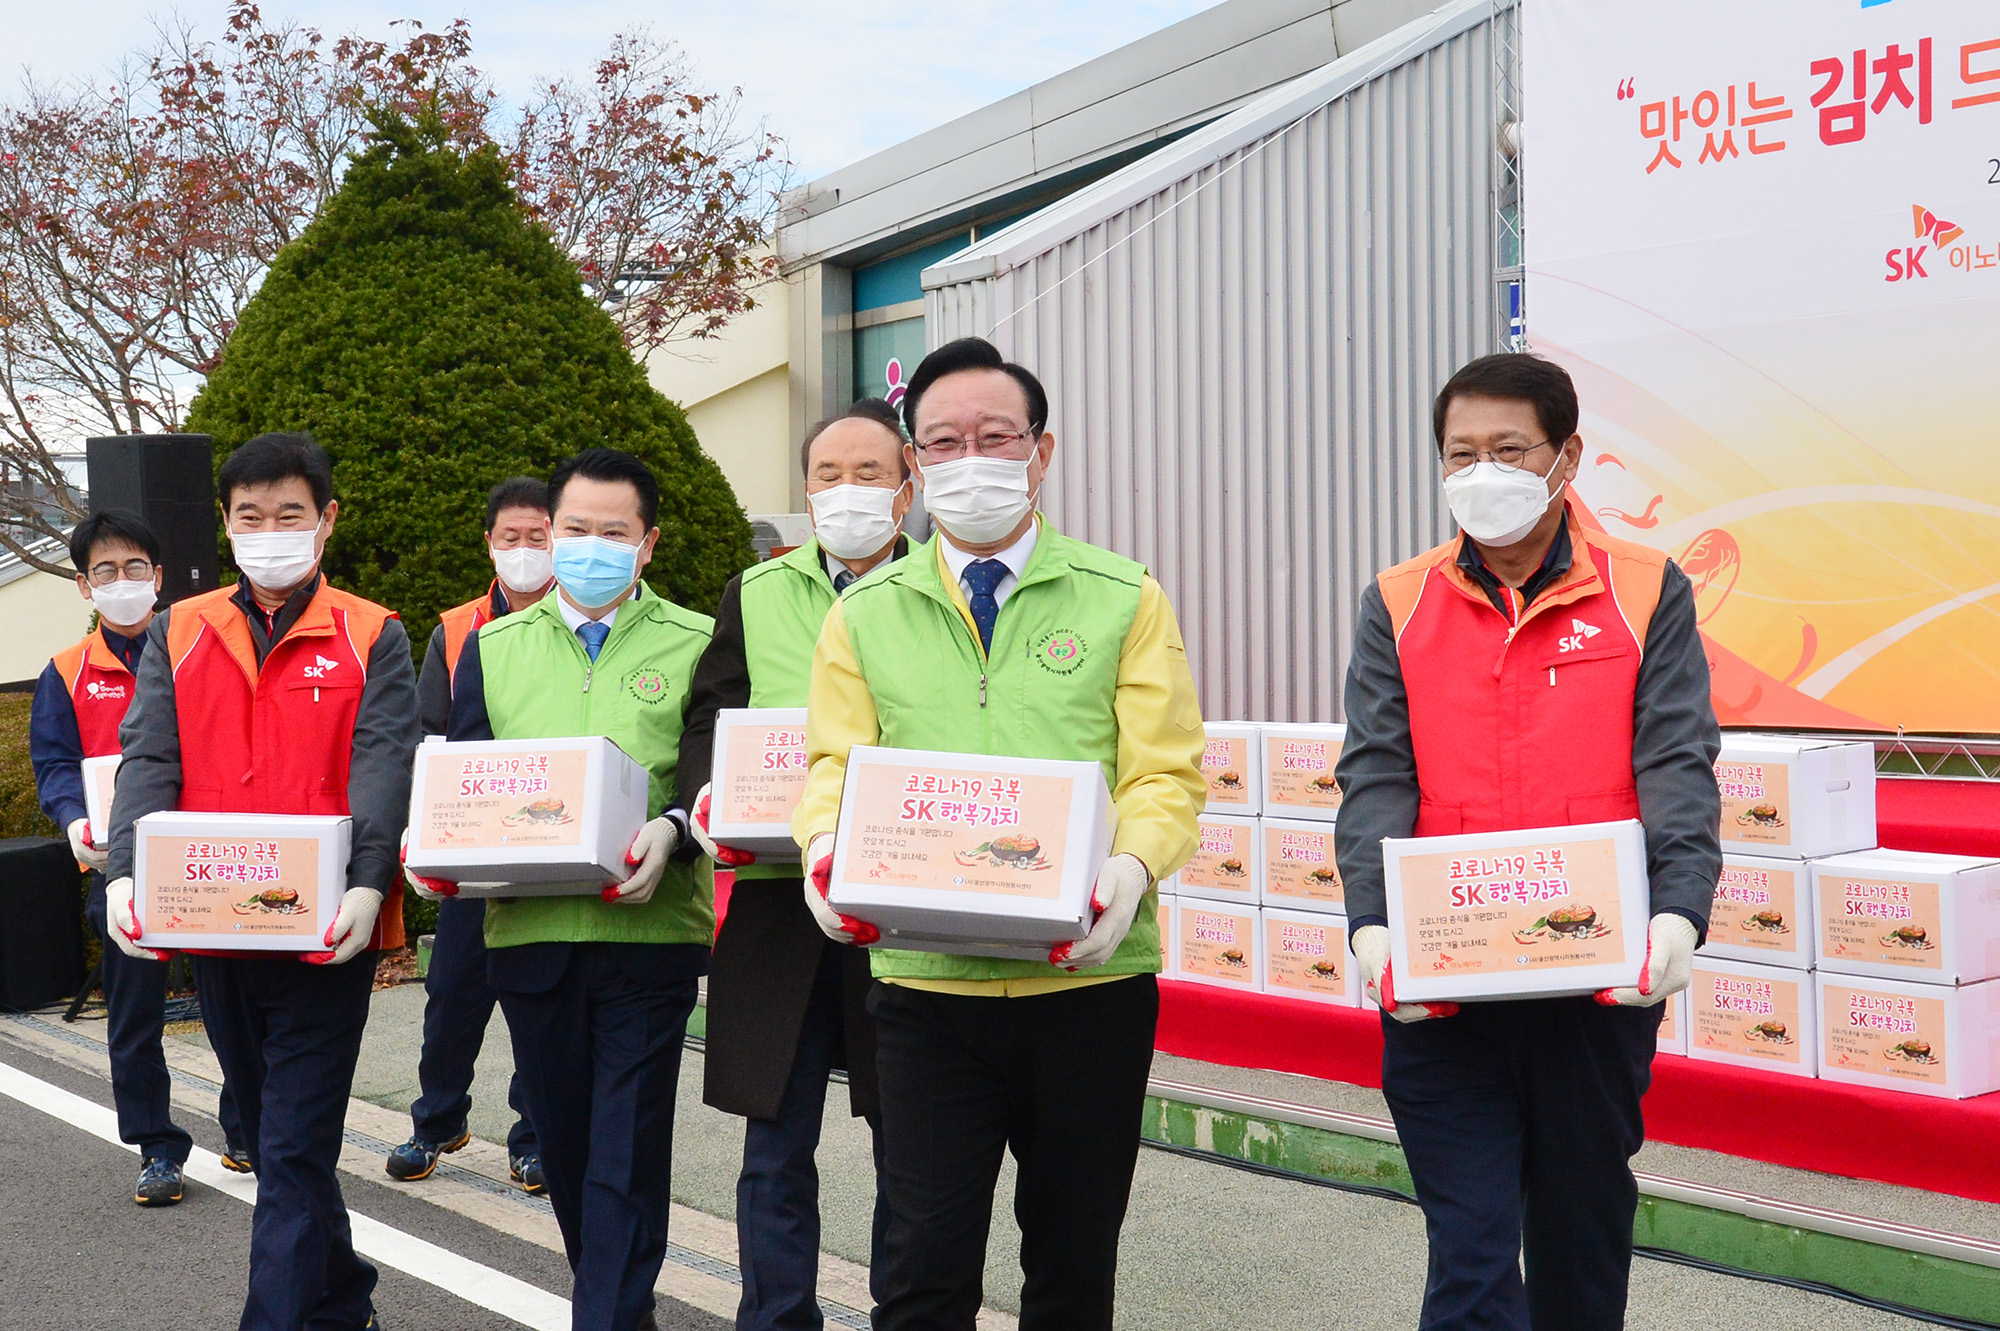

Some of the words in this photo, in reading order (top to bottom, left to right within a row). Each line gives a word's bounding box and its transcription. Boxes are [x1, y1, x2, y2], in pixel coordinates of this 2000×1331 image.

[1810, 36, 1933, 147] 김치
[1885, 245, 1929, 283] SK
[1949, 242, 2000, 272] 이노
[1558, 634, 1584, 652] SK
[303, 666, 324, 678] SK
[766, 732, 806, 747] 코로나
[1284, 743, 1312, 754] 코로나19
[1314, 743, 1325, 755] 극복
[463, 759, 520, 775] 코로나19
[525, 756, 548, 773] 극복
[764, 752, 789, 769] SK
[1284, 756, 1296, 769] SK
[1297, 757, 1326, 770] 행복김치
[1714, 766, 1744, 780] 로나19
[1747, 766, 1763, 781] 극복
[460, 779, 485, 796] SK
[489, 778, 548, 795] 행복김치
[905, 775, 982, 798] 코로나19
[989, 778, 1021, 803] 극복
[1725, 783, 1765, 799] 행복김치
[901, 798, 936, 821] SK
[940, 801, 1019, 827] 행복김치
[864, 824, 894, 835] 코로나19
[1200, 826, 1220, 837] 로나19
[1223, 828, 1233, 840] 극복
[1199, 841, 1205, 850] K
[1206, 840, 1233, 853] 행복김치
[1282, 834, 1310, 846] 코로나19
[1313, 836, 1324, 848] 극복
[186, 843, 248, 860] 코로나19
[254, 842, 279, 862] 극복
[1281, 847, 1294, 859] SK
[1295, 849, 1324, 863] 행복김치
[1450, 856, 1526, 879] 코로나19
[1533, 849, 1565, 875] 극복
[186, 863, 212, 881] SK
[216, 864, 279, 883] 행복김치
[868, 869, 881, 878] SK
[1719, 869, 1749, 885] 로나19
[1753, 871, 1768, 887] 극복
[1451, 884, 1485, 907] SK
[1489, 879, 1569, 904] 행복김치
[1730, 887, 1770, 904] 행복김치
[1846, 883, 1888, 899] 코로나19
[1891, 885, 1910, 902] 극복
[1846, 900, 1864, 916] SK
[1866, 902, 1913, 920] 행복김치
[1195, 914, 1222, 927] 코로나19
[1223, 918, 1234, 929] 극복
[1419, 916, 1448, 925] 코로나19
[1195, 927, 1206, 939] SK
[1208, 929, 1235, 944] 행복김치
[1282, 926, 1311, 938] 코로나19
[1313, 929, 1325, 941] 극복
[1282, 939, 1294, 951] SK
[1296, 941, 1325, 955] 행복김치
[1433, 962, 1445, 970] SK
[1715, 978, 1753, 997] 코로나19
[1755, 982, 1772, 998] 극복
[1714, 994, 1731, 1009] SK
[1733, 994, 1773, 1015] 행복김치
[1850, 994, 1893, 1014] 코로나19
[1897, 999, 1915, 1016] 극복
[1850, 1010, 1868, 1028] SK
[1871, 1011, 1918, 1033] 행복김치
